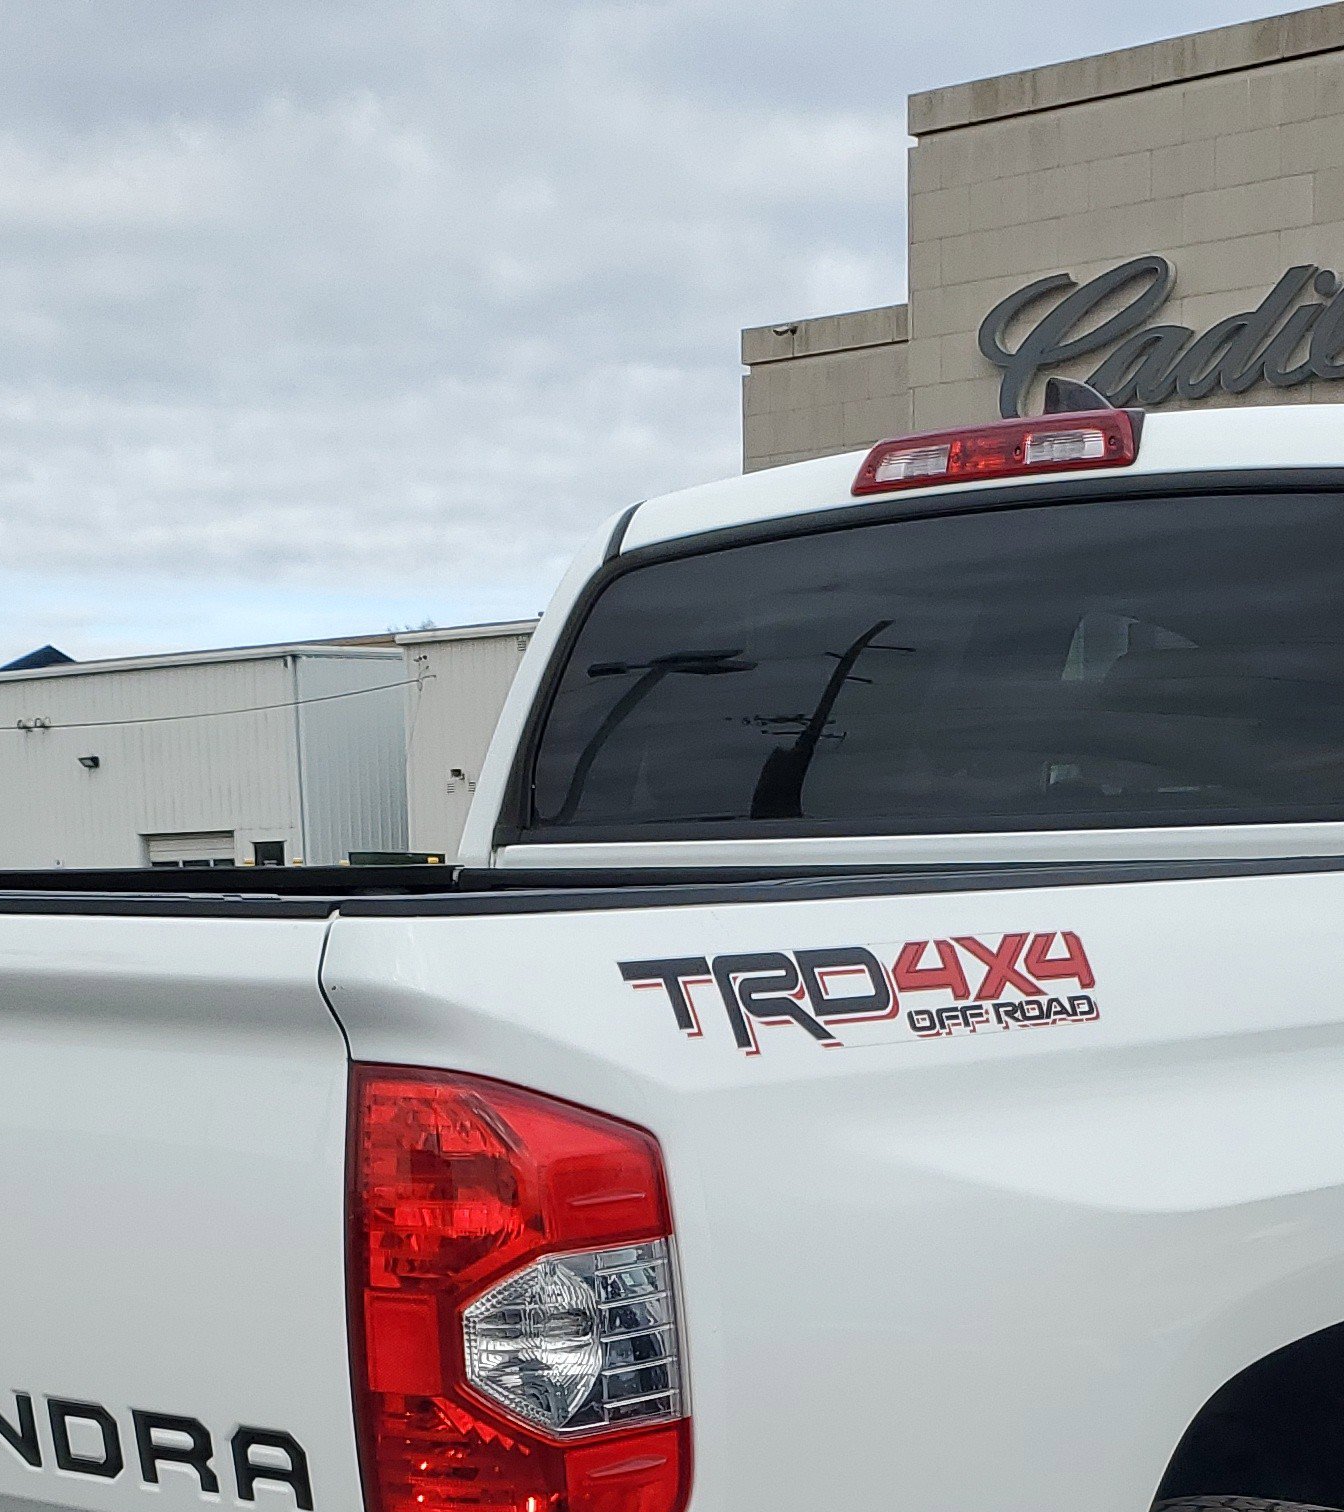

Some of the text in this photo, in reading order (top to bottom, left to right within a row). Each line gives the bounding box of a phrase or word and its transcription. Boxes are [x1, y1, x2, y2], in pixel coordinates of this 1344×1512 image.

[616, 945, 897, 1056] TRD
[907, 995, 1099, 1036] OFF ROAD
